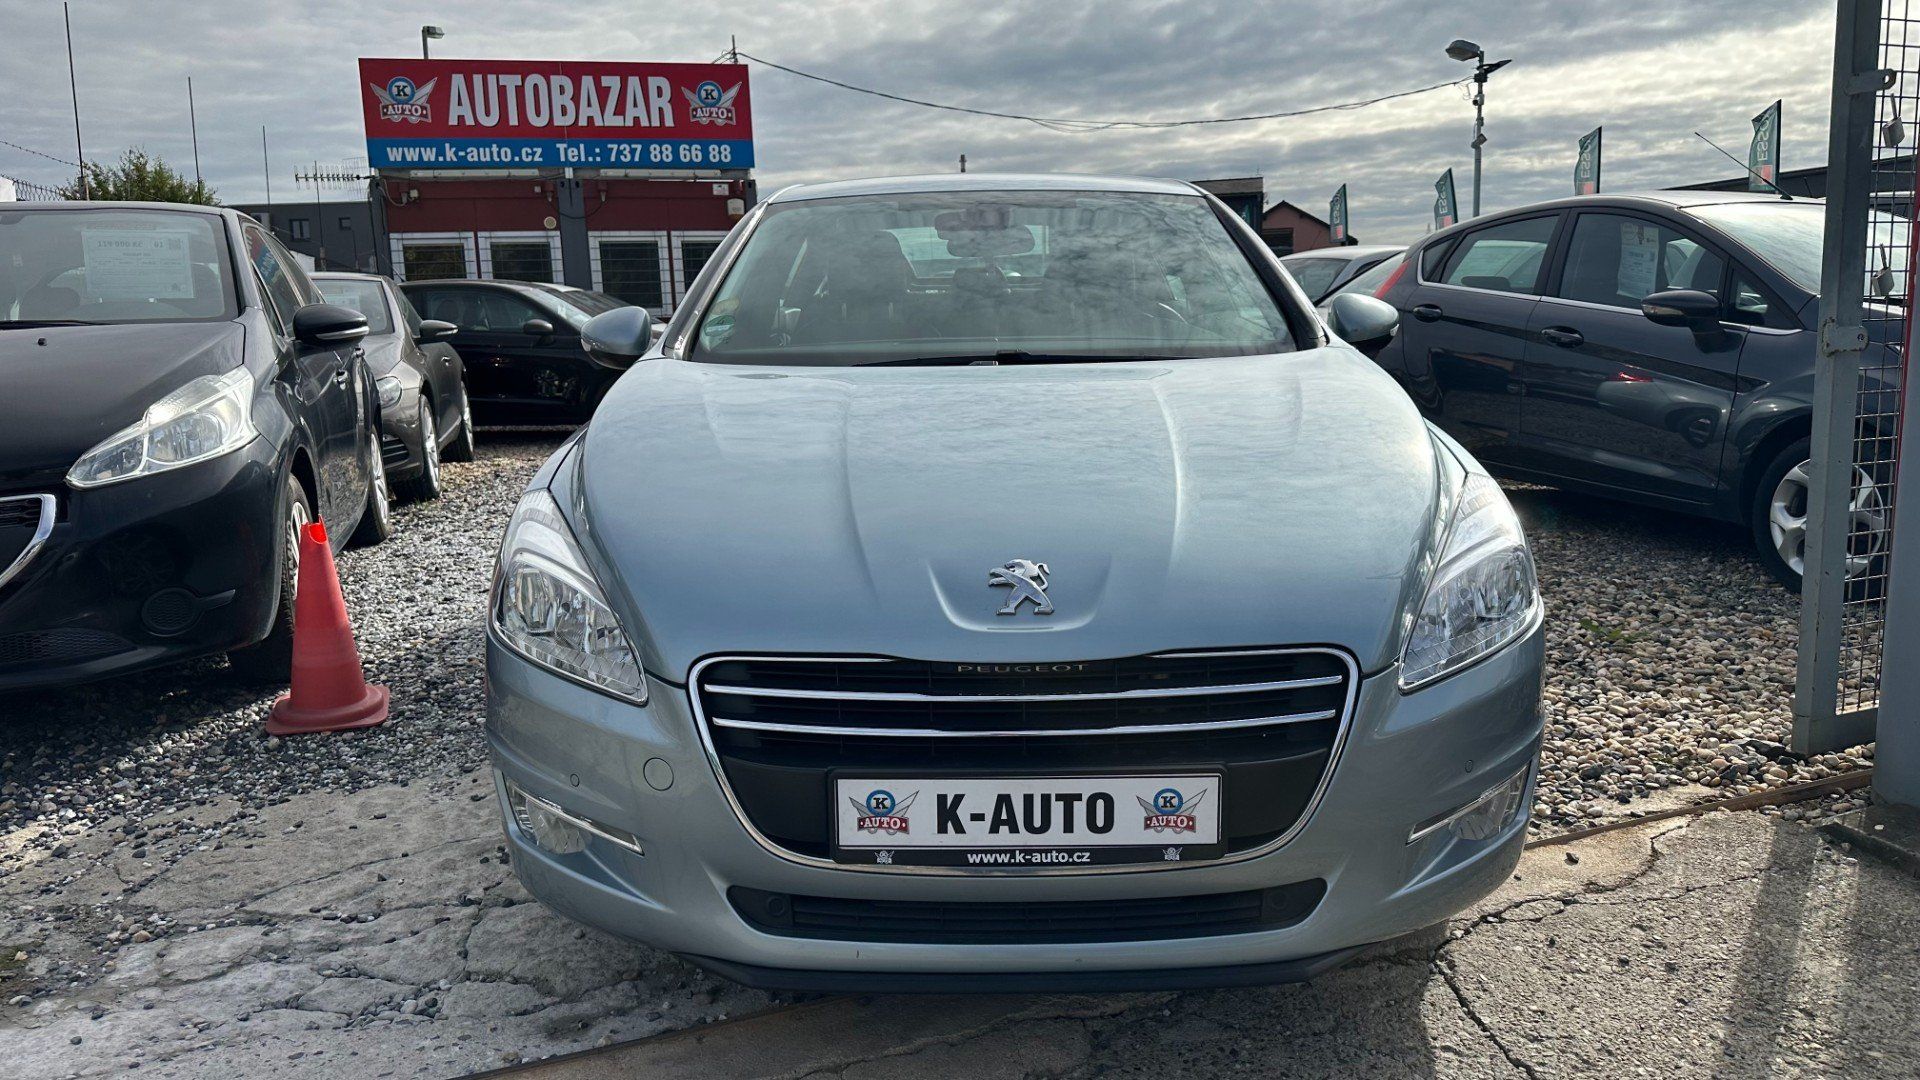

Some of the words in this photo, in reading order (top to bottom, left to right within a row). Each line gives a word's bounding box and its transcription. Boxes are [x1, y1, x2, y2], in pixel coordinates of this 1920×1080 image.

[394, 85, 409, 98] K
[702, 88, 717, 100] K
[448, 73, 675, 127] AUTOBAZAR
[387, 104, 422, 116] AUTO
[695, 107, 727, 118] AUTO
[386, 143, 543, 162] www.k-auto.cz
[555, 143, 600, 162] Tel.:
[607, 144, 643, 163] 737
[650, 144, 673, 163] 88
[679, 144, 702, 163] 66
[709, 144, 732, 163] 88
[957, 664, 1088, 673] PEUGEOT
[873, 797, 888, 809] K
[1160, 795, 1176, 808] K
[936, 792, 1115, 835] K-AUTO
[863, 817, 901, 829] AUTO
[1150, 816, 1188, 828] AUTO
[967, 850, 1090, 864] www.k-auto.cz
